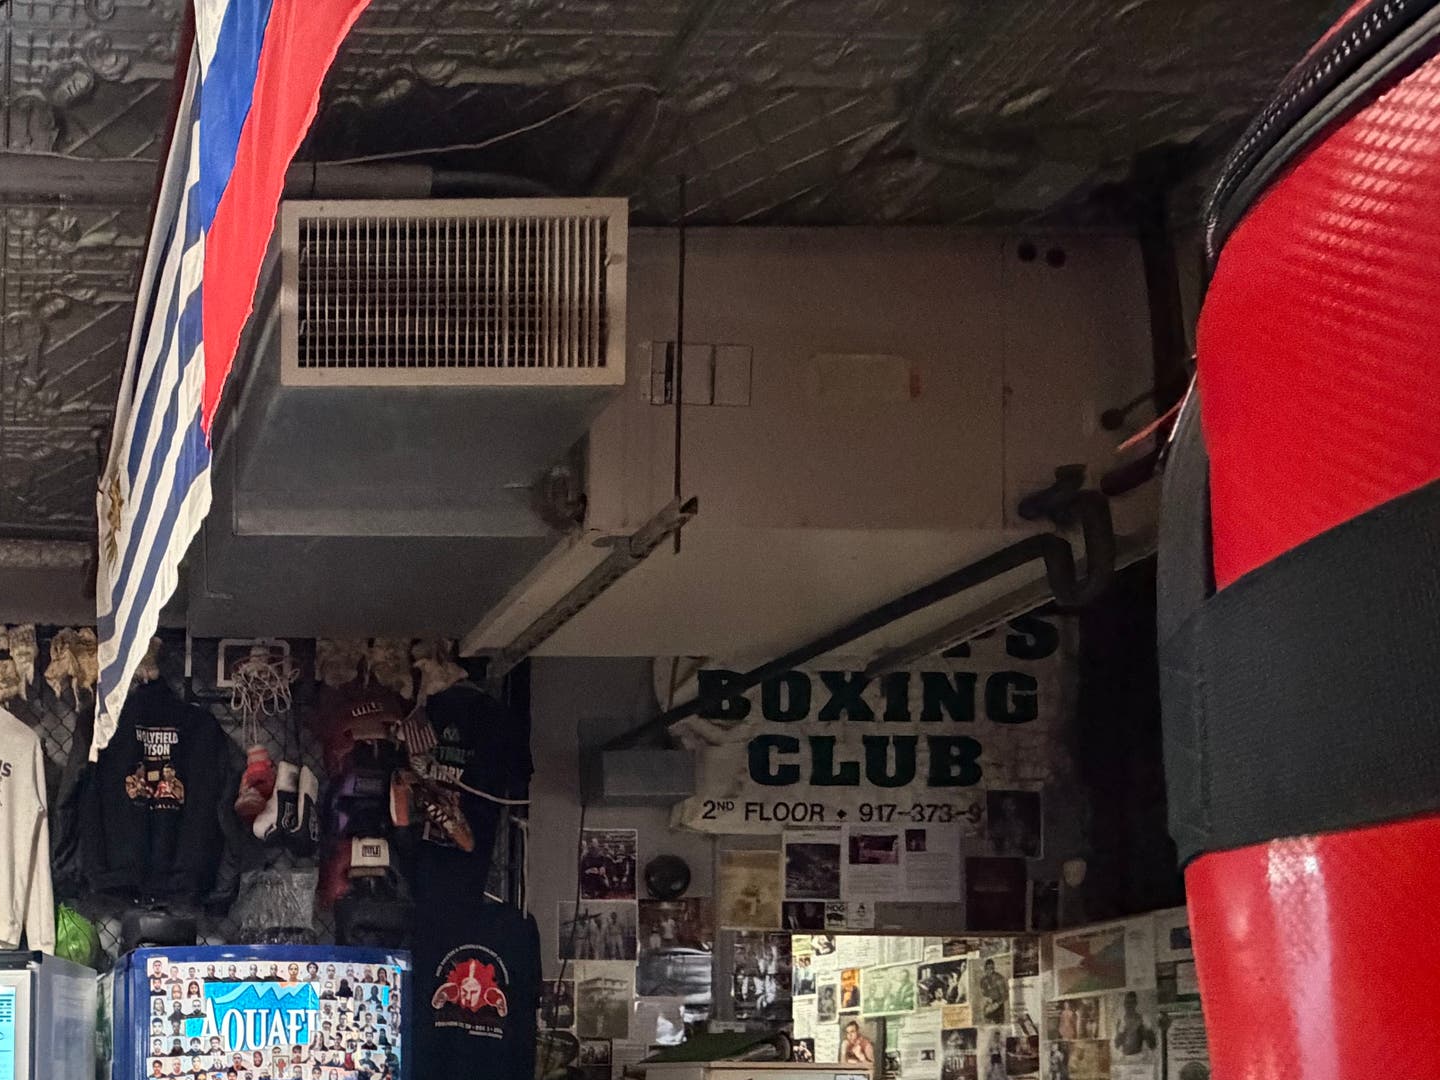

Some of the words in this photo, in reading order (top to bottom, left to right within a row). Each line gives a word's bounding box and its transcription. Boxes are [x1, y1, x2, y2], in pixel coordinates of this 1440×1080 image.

[697, 669, 1039, 724] BOXING
[135, 728, 179, 744] HOLYFIELD
[144, 743, 171, 756] TYSON
[747, 734, 984, 788] CLUB
[702, 799, 735, 820] 2ND
[745, 801, 825, 822] FLOOR
